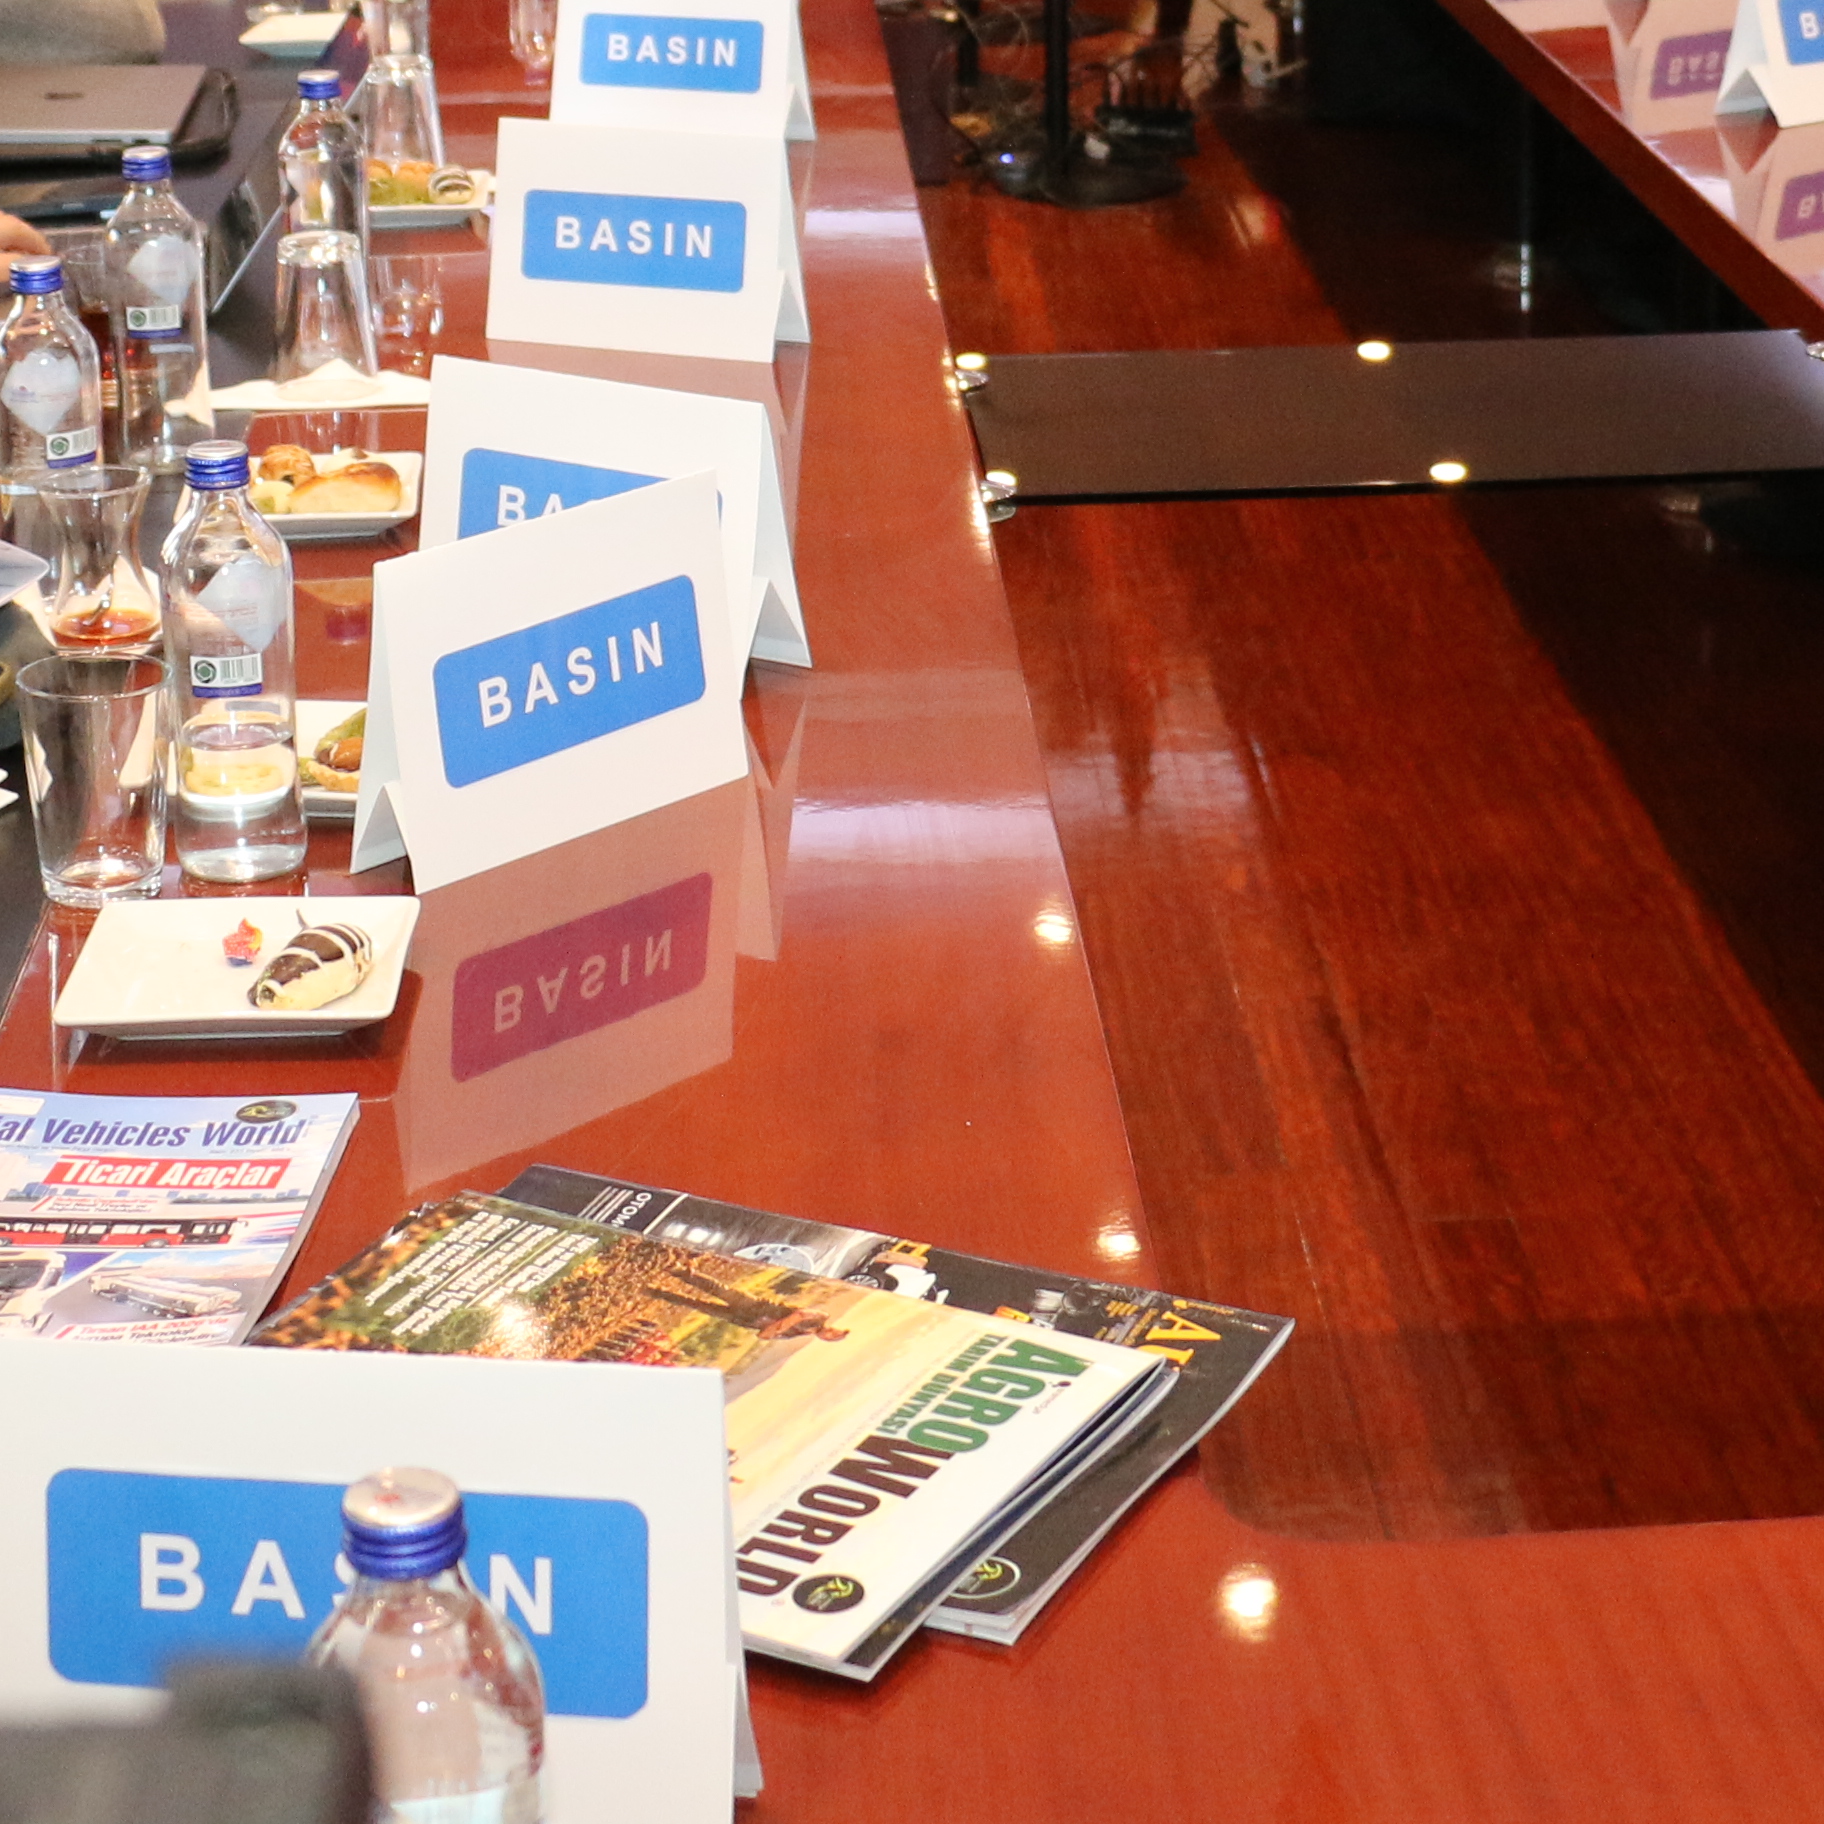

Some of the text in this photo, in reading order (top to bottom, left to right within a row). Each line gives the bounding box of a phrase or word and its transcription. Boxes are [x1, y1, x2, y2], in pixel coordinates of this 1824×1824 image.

[606, 32, 737, 67] BASIN
[554, 214, 714, 259] BASIN
[477, 621, 665, 729] BASIN
[42, 1118, 187, 1149] Vehicles
[200, 1118, 305, 1147] World
[55, 1157, 282, 1190] Ticari Araçlar
[875, 1333, 1009, 1435] TARIM DÜNYASI
[138, 1531, 553, 1640] BAN
